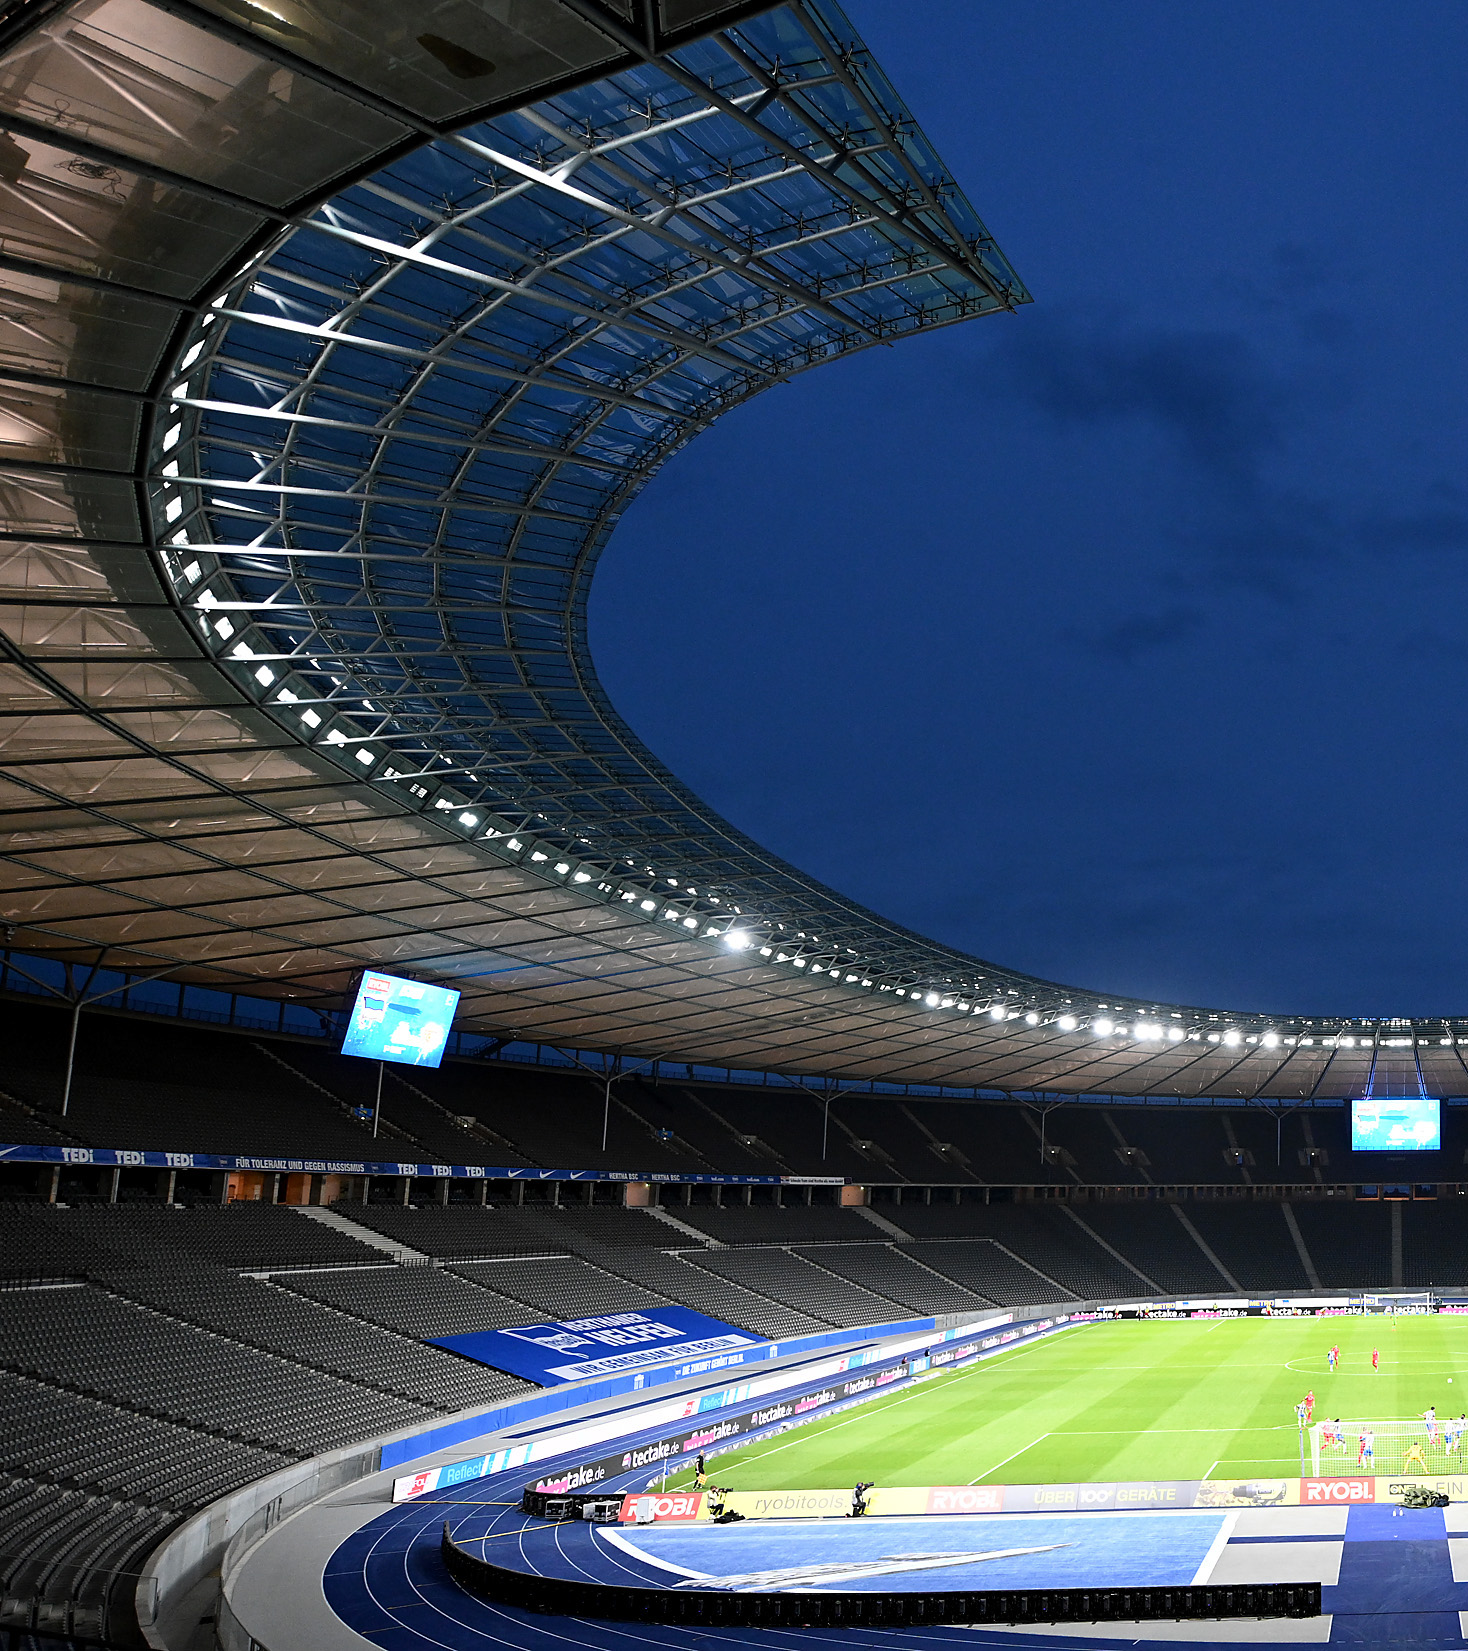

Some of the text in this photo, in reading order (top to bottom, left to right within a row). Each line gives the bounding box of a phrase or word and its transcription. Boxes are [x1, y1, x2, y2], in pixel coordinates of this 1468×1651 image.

[62, 1148, 94, 1162] TEDi
[114, 1150, 146, 1165] TEDi
[165, 1153, 194, 1167] TEDi
[235, 1157, 365, 1172] FÜR TOLERANZ UND GEGEN RASSISMUS
[397, 1164, 418, 1175] TEDi
[432, 1165, 452, 1176] TEDi
[465, 1167, 485, 1177] TEDi
[609, 1172, 639, 1181] HERTHA BSC
[651, 1173, 681, 1182] HERTHA BSC
[582, 1322, 688, 1346] HELFEN
[570, 1338, 737, 1375] WIR GEMEINSAM FÜR BERLIN
[757, 1404, 792, 1426] tectake.de
[632, 1441, 680, 1468] tectake.de
[1436, 1481, 1463, 1495] EIN
[1034, 1489, 1075, 1505] ÜBER
[1116, 1487, 1177, 1502] GERÄTE
[626, 1497, 696, 1517] ROBI.
[755, 1494, 871, 1514] ryobitools.
